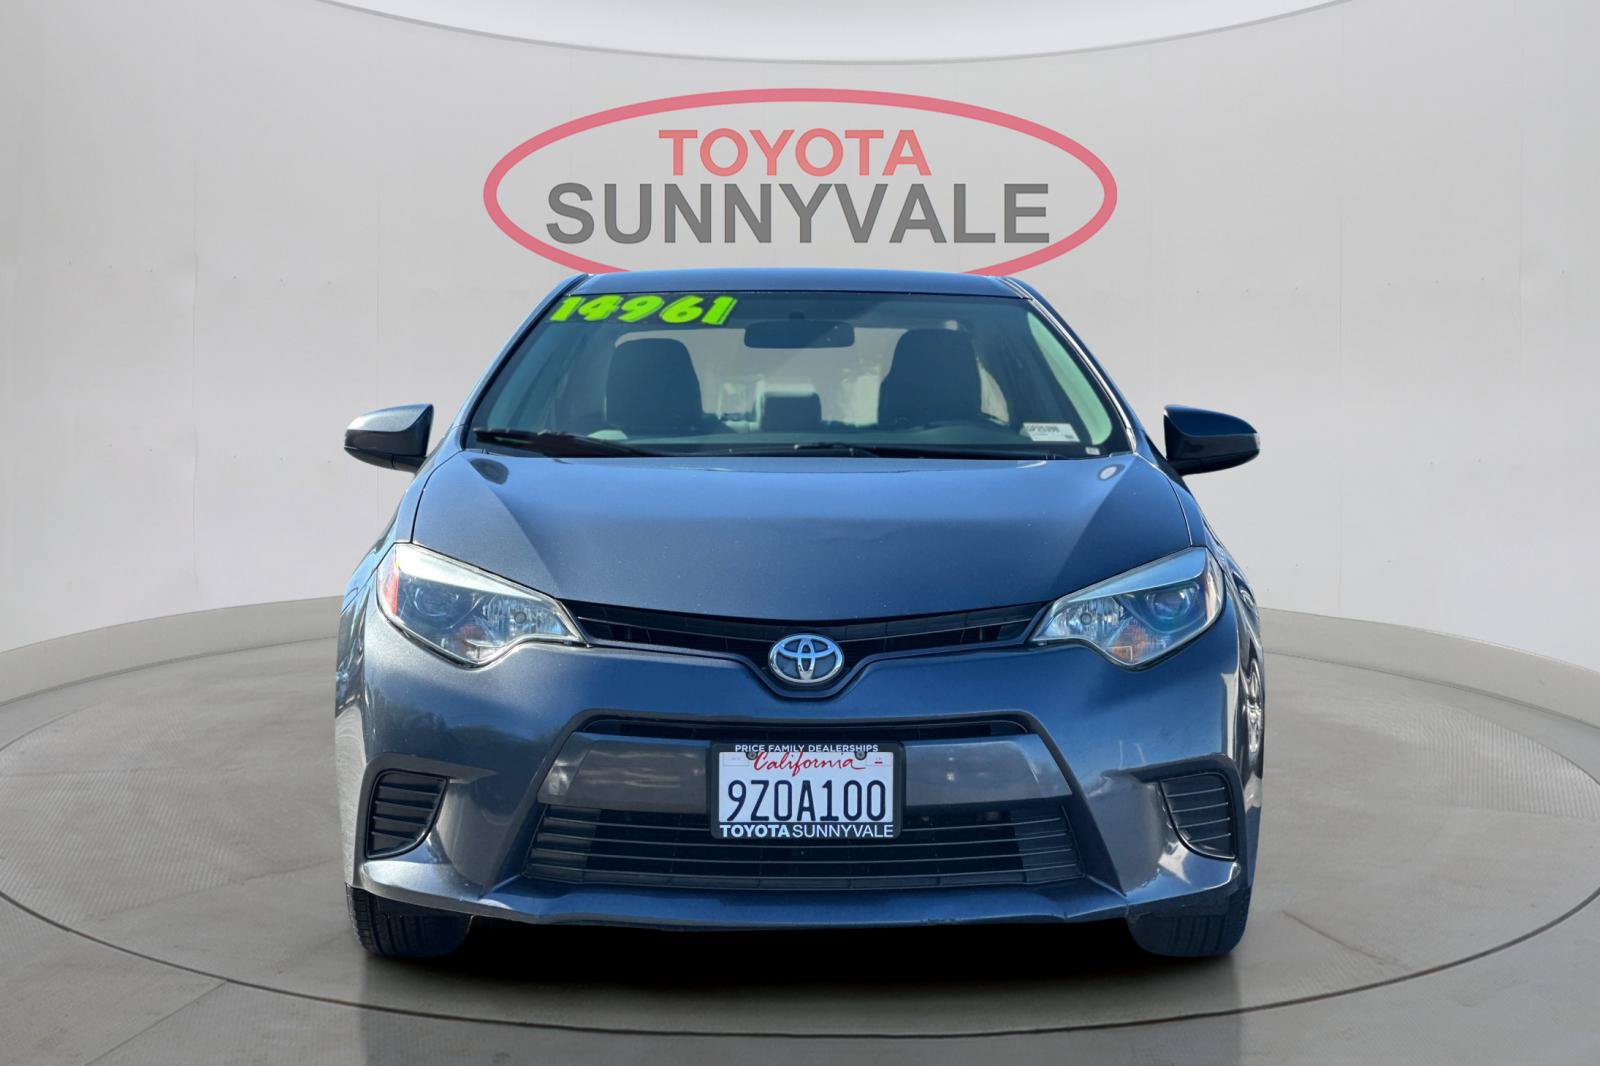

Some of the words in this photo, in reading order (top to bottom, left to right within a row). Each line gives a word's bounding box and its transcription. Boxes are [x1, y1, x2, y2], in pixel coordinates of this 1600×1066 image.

[659, 129, 932, 176] TOYOTA
[546, 182, 1050, 244] SUNNYVALE
[550, 295, 737, 324] 14961
[735, 744, 765, 752] PRICE
[768, 744, 804, 752] FAMILY
[808, 744, 878, 752] DEALERSHIPS
[753, 751, 866, 777] California
